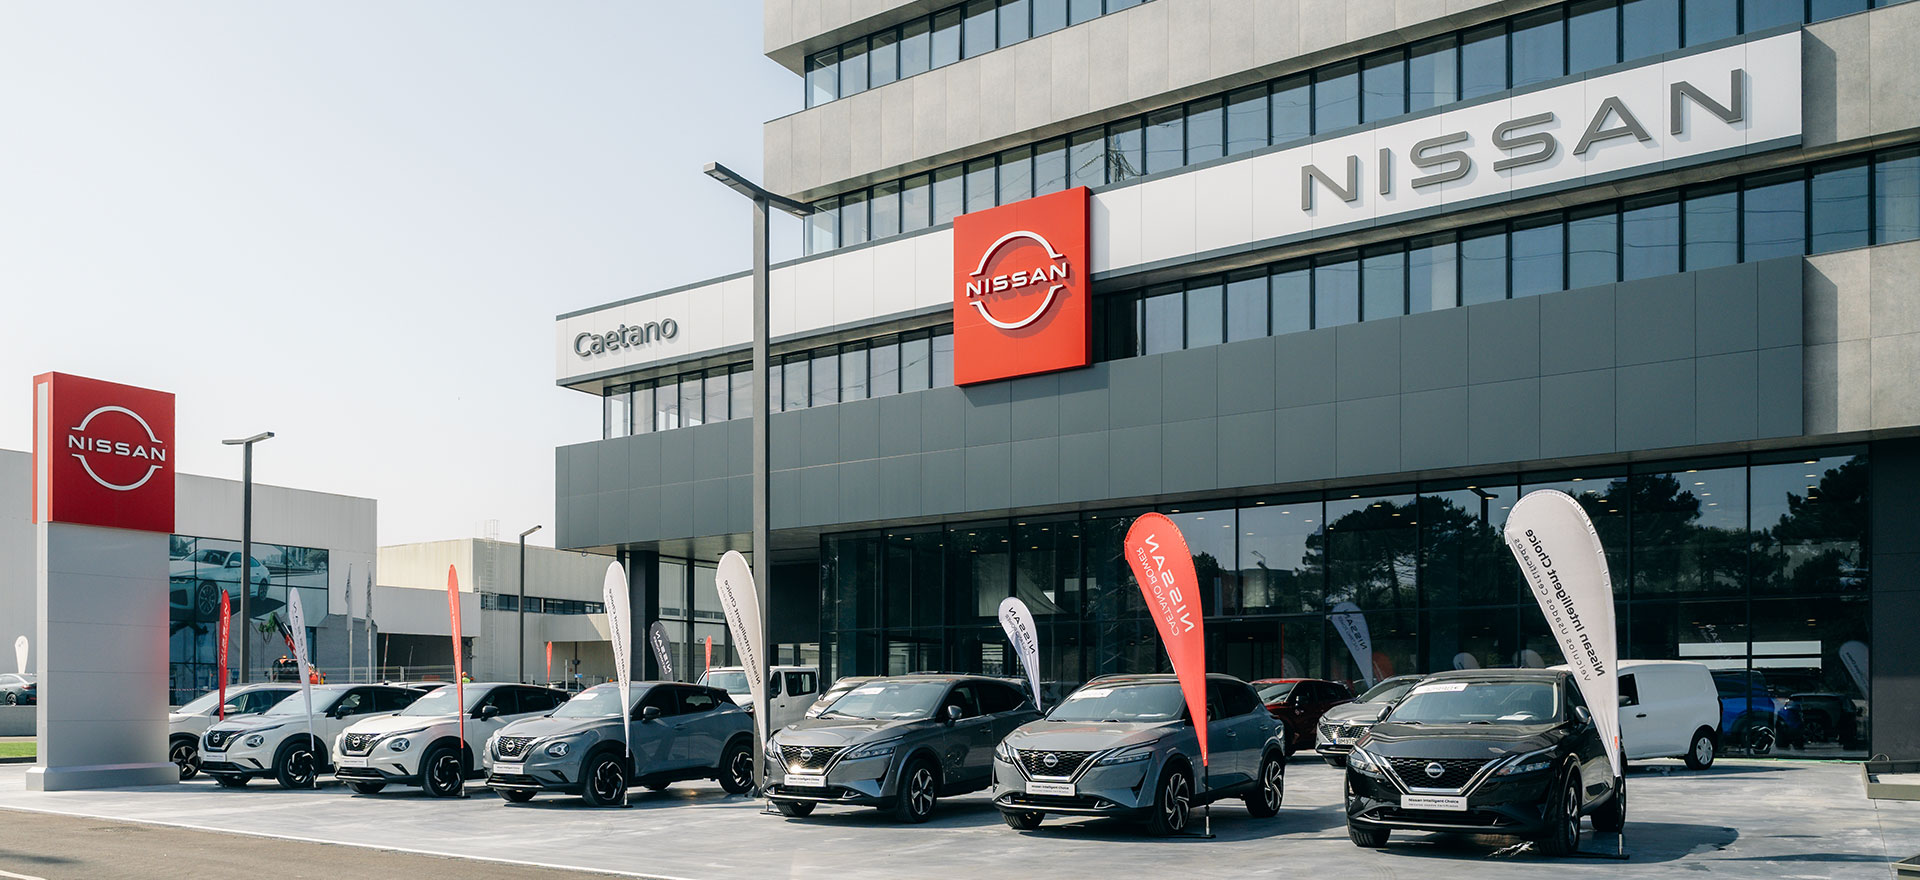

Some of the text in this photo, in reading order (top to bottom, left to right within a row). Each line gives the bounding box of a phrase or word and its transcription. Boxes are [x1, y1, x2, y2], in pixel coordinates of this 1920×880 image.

[1302, 69, 1744, 211] NISSAN
[966, 262, 1069, 298] NISSAN
[573, 315, 678, 358] Caetano
[68, 434, 166, 462] NISSAN
